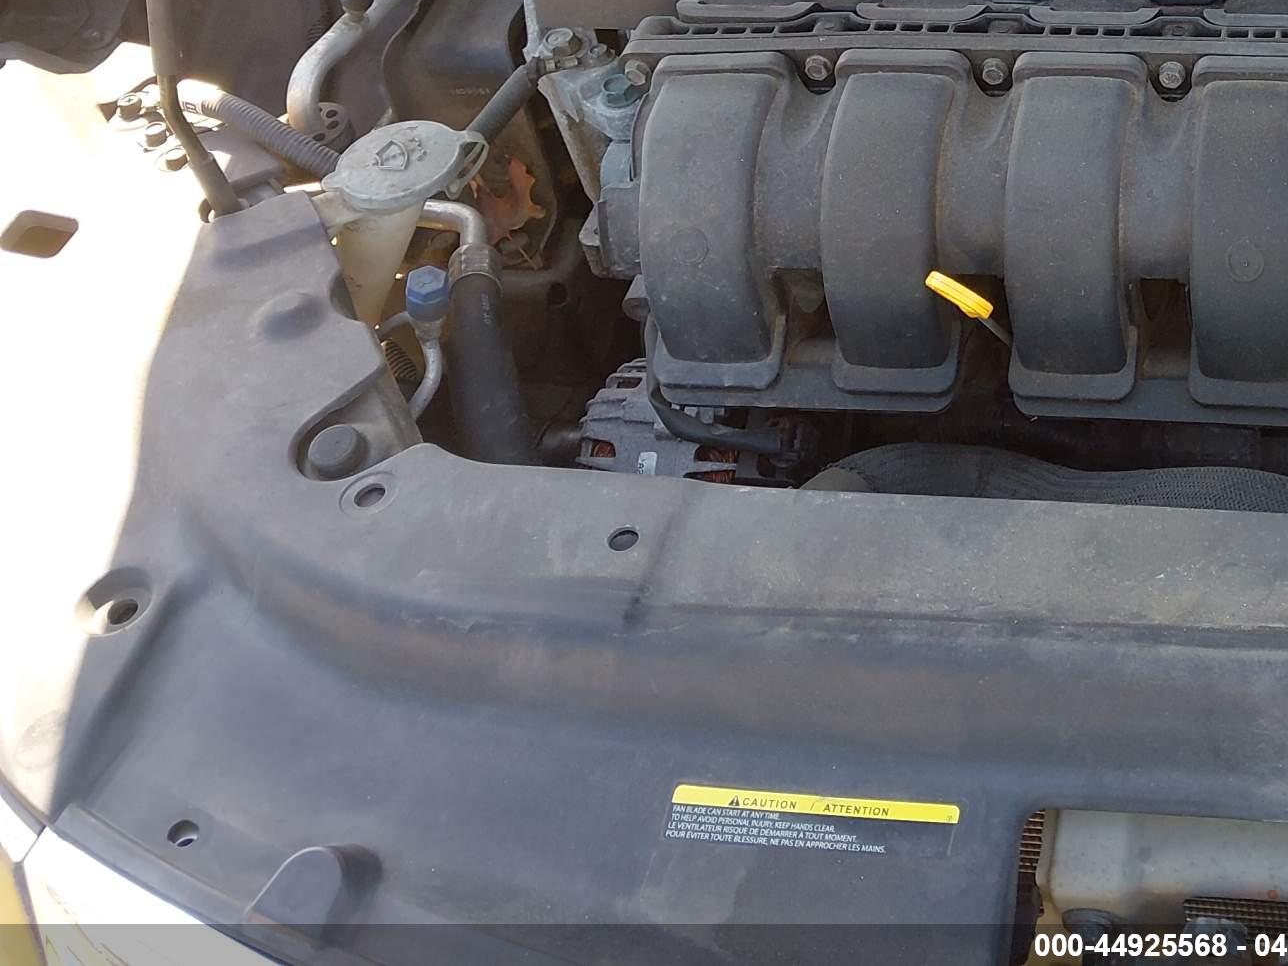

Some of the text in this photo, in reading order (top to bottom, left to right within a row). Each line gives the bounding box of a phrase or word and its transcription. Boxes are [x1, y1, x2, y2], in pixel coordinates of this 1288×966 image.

[686, 806, 706, 814] BLADE
[707, 807, 721, 815] CAN
[722, 808, 740, 816] START
[750, 810, 764, 819] ANY
[743, 797, 797, 810] CAUTION
[822, 803, 889, 817] ATTENTION
[671, 813, 680, 821] TO
[681, 814, 697, 822] HELP
[697, 815, 718, 823] AVOID
[774, 821, 791, 830] KEEP
[791, 822, 813, 831] HANDS
[677, 822, 722, 832] VENTILATEUR
[723, 825, 748, 835] RISQUE
[748, 827, 759, 835] DE
[805, 832, 824, 840] TOUT
[665, 830, 685, 838] POUR
[710, 833, 733, 842] TOUTE
[770, 838, 780, 846] NE
[780, 839, 794, 847] PAS
[805, 841, 848, 851] APPROCHER
[848, 843, 860, 852] LES
